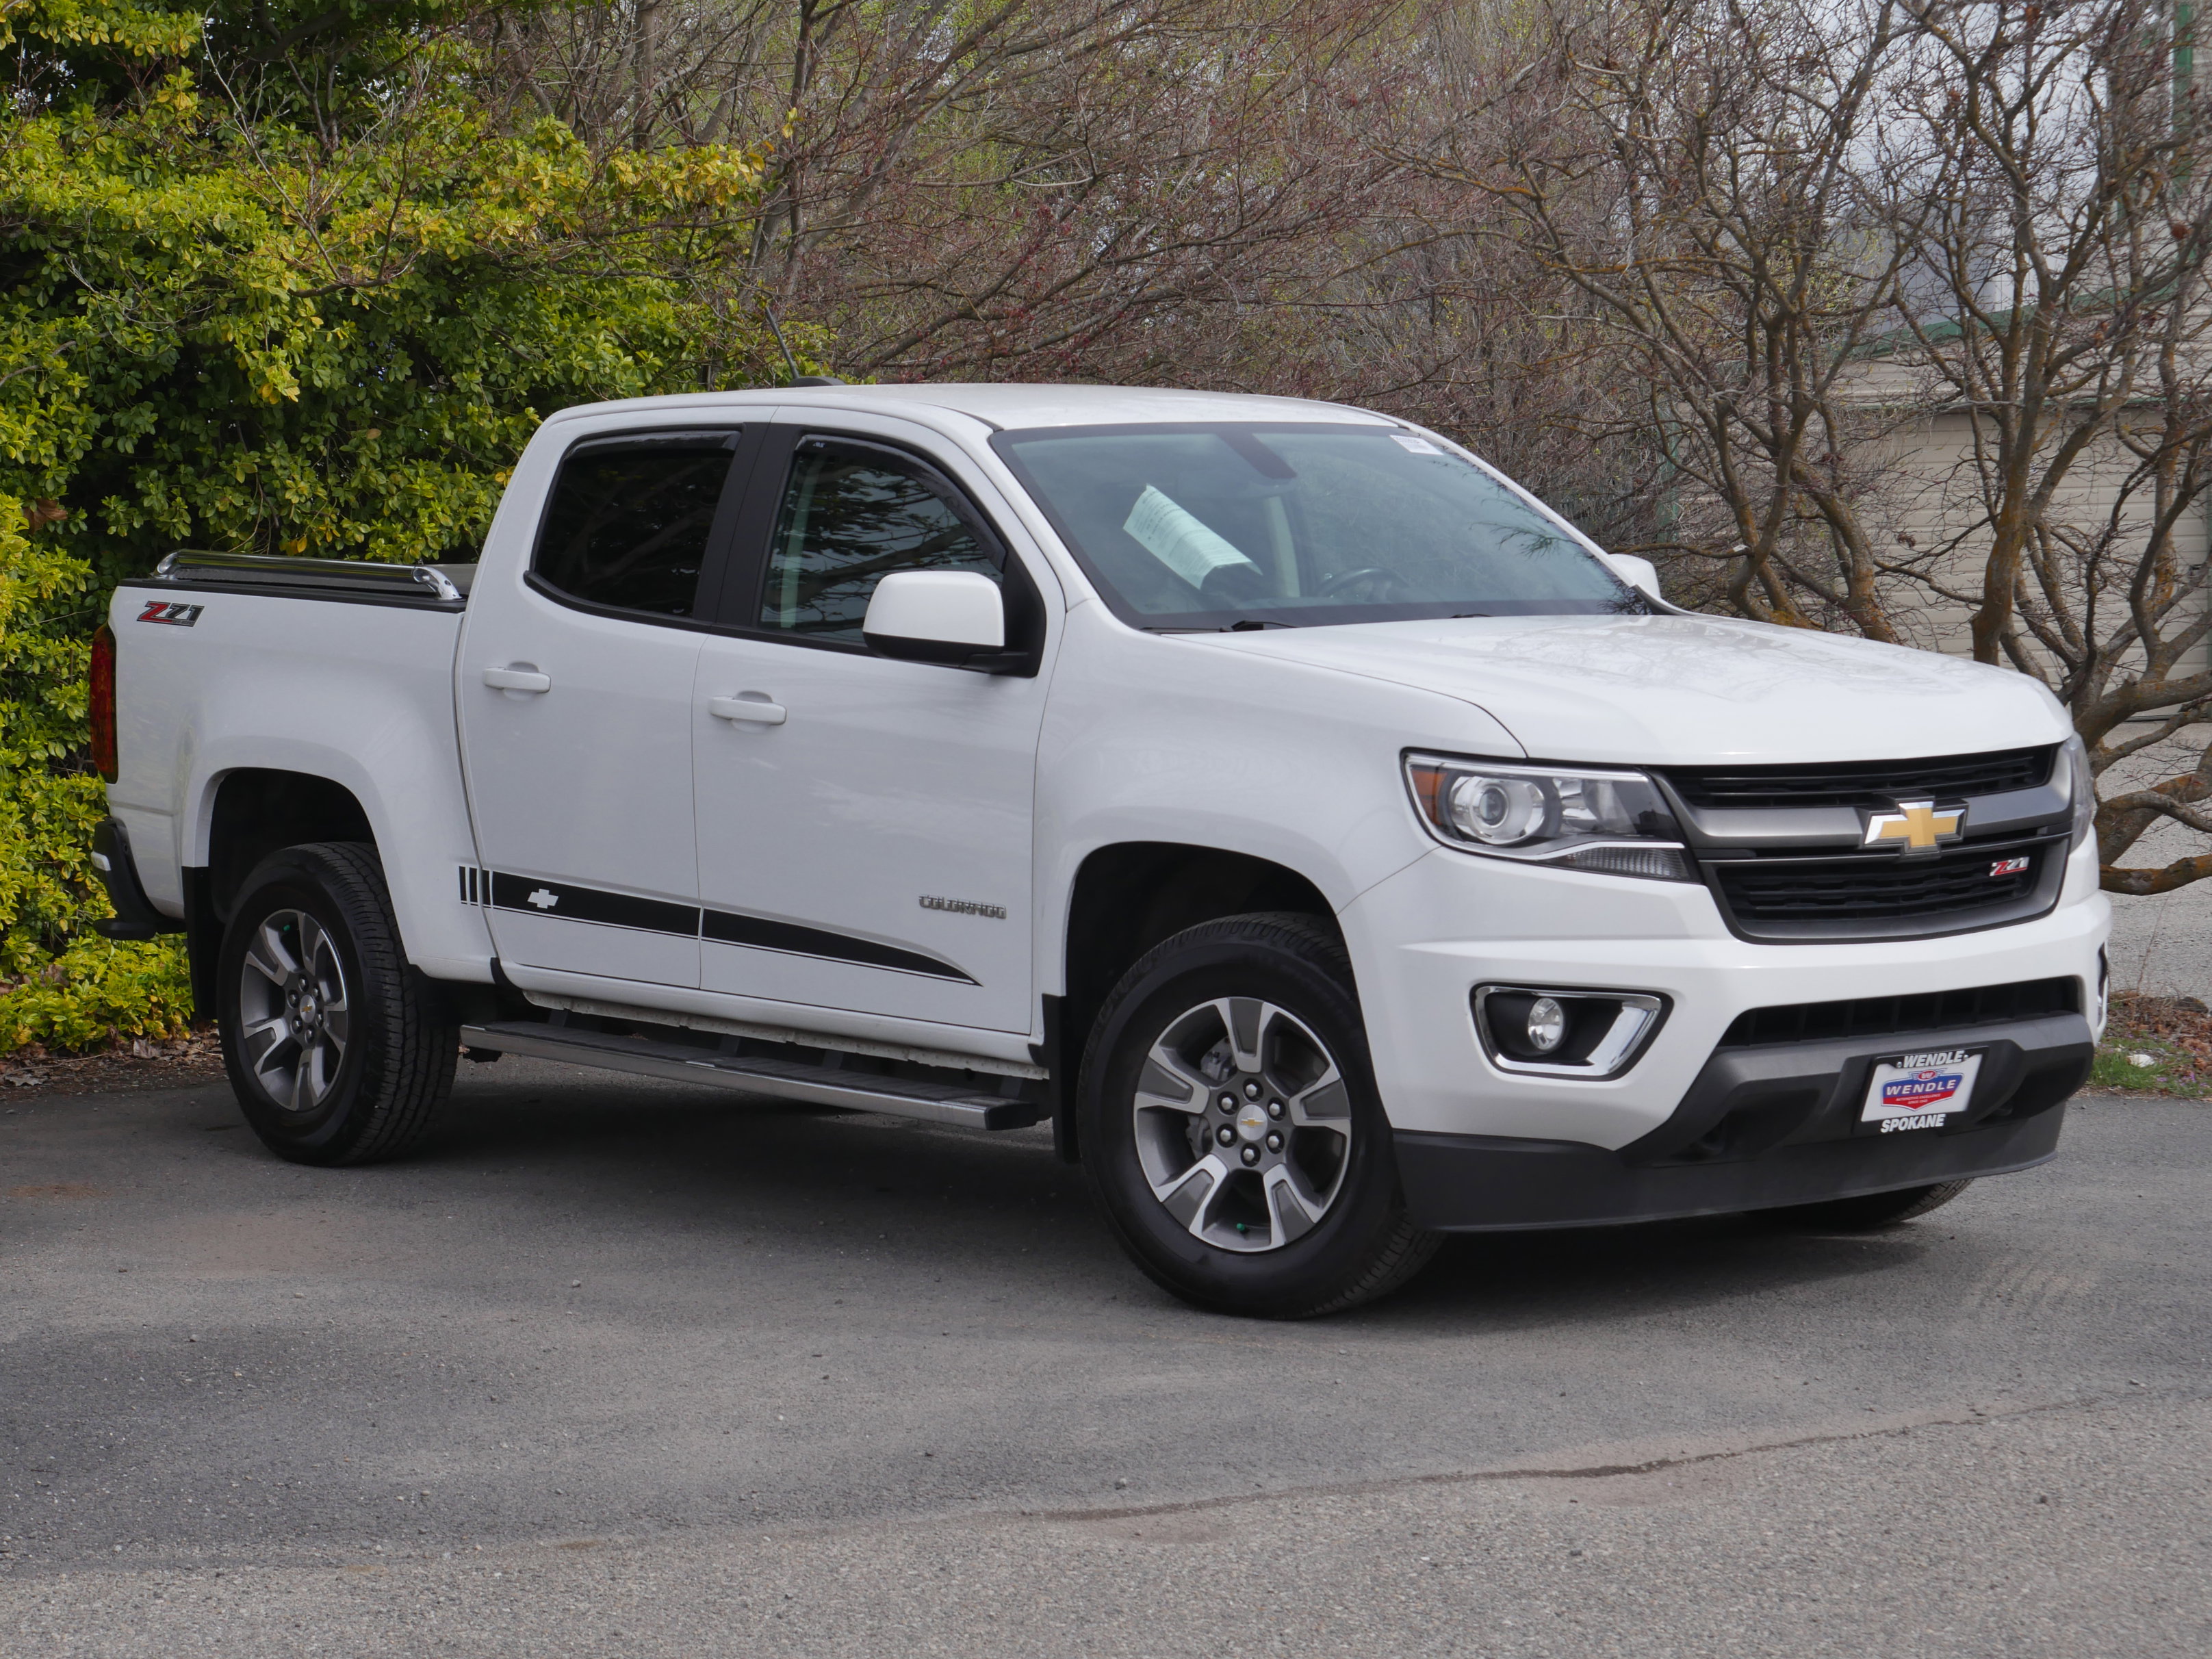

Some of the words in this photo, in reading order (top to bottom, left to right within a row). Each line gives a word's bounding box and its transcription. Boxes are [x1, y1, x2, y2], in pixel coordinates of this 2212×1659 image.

[137, 600, 205, 627] Z71
[1990, 856, 2030, 877] Z71
[918, 894, 1007, 920] COLORADO
[1903, 1050, 1965, 1068] WENDLE
[1886, 1079, 1957, 1096] WENDLE
[1880, 1114, 1946, 1133] SPOKANE
